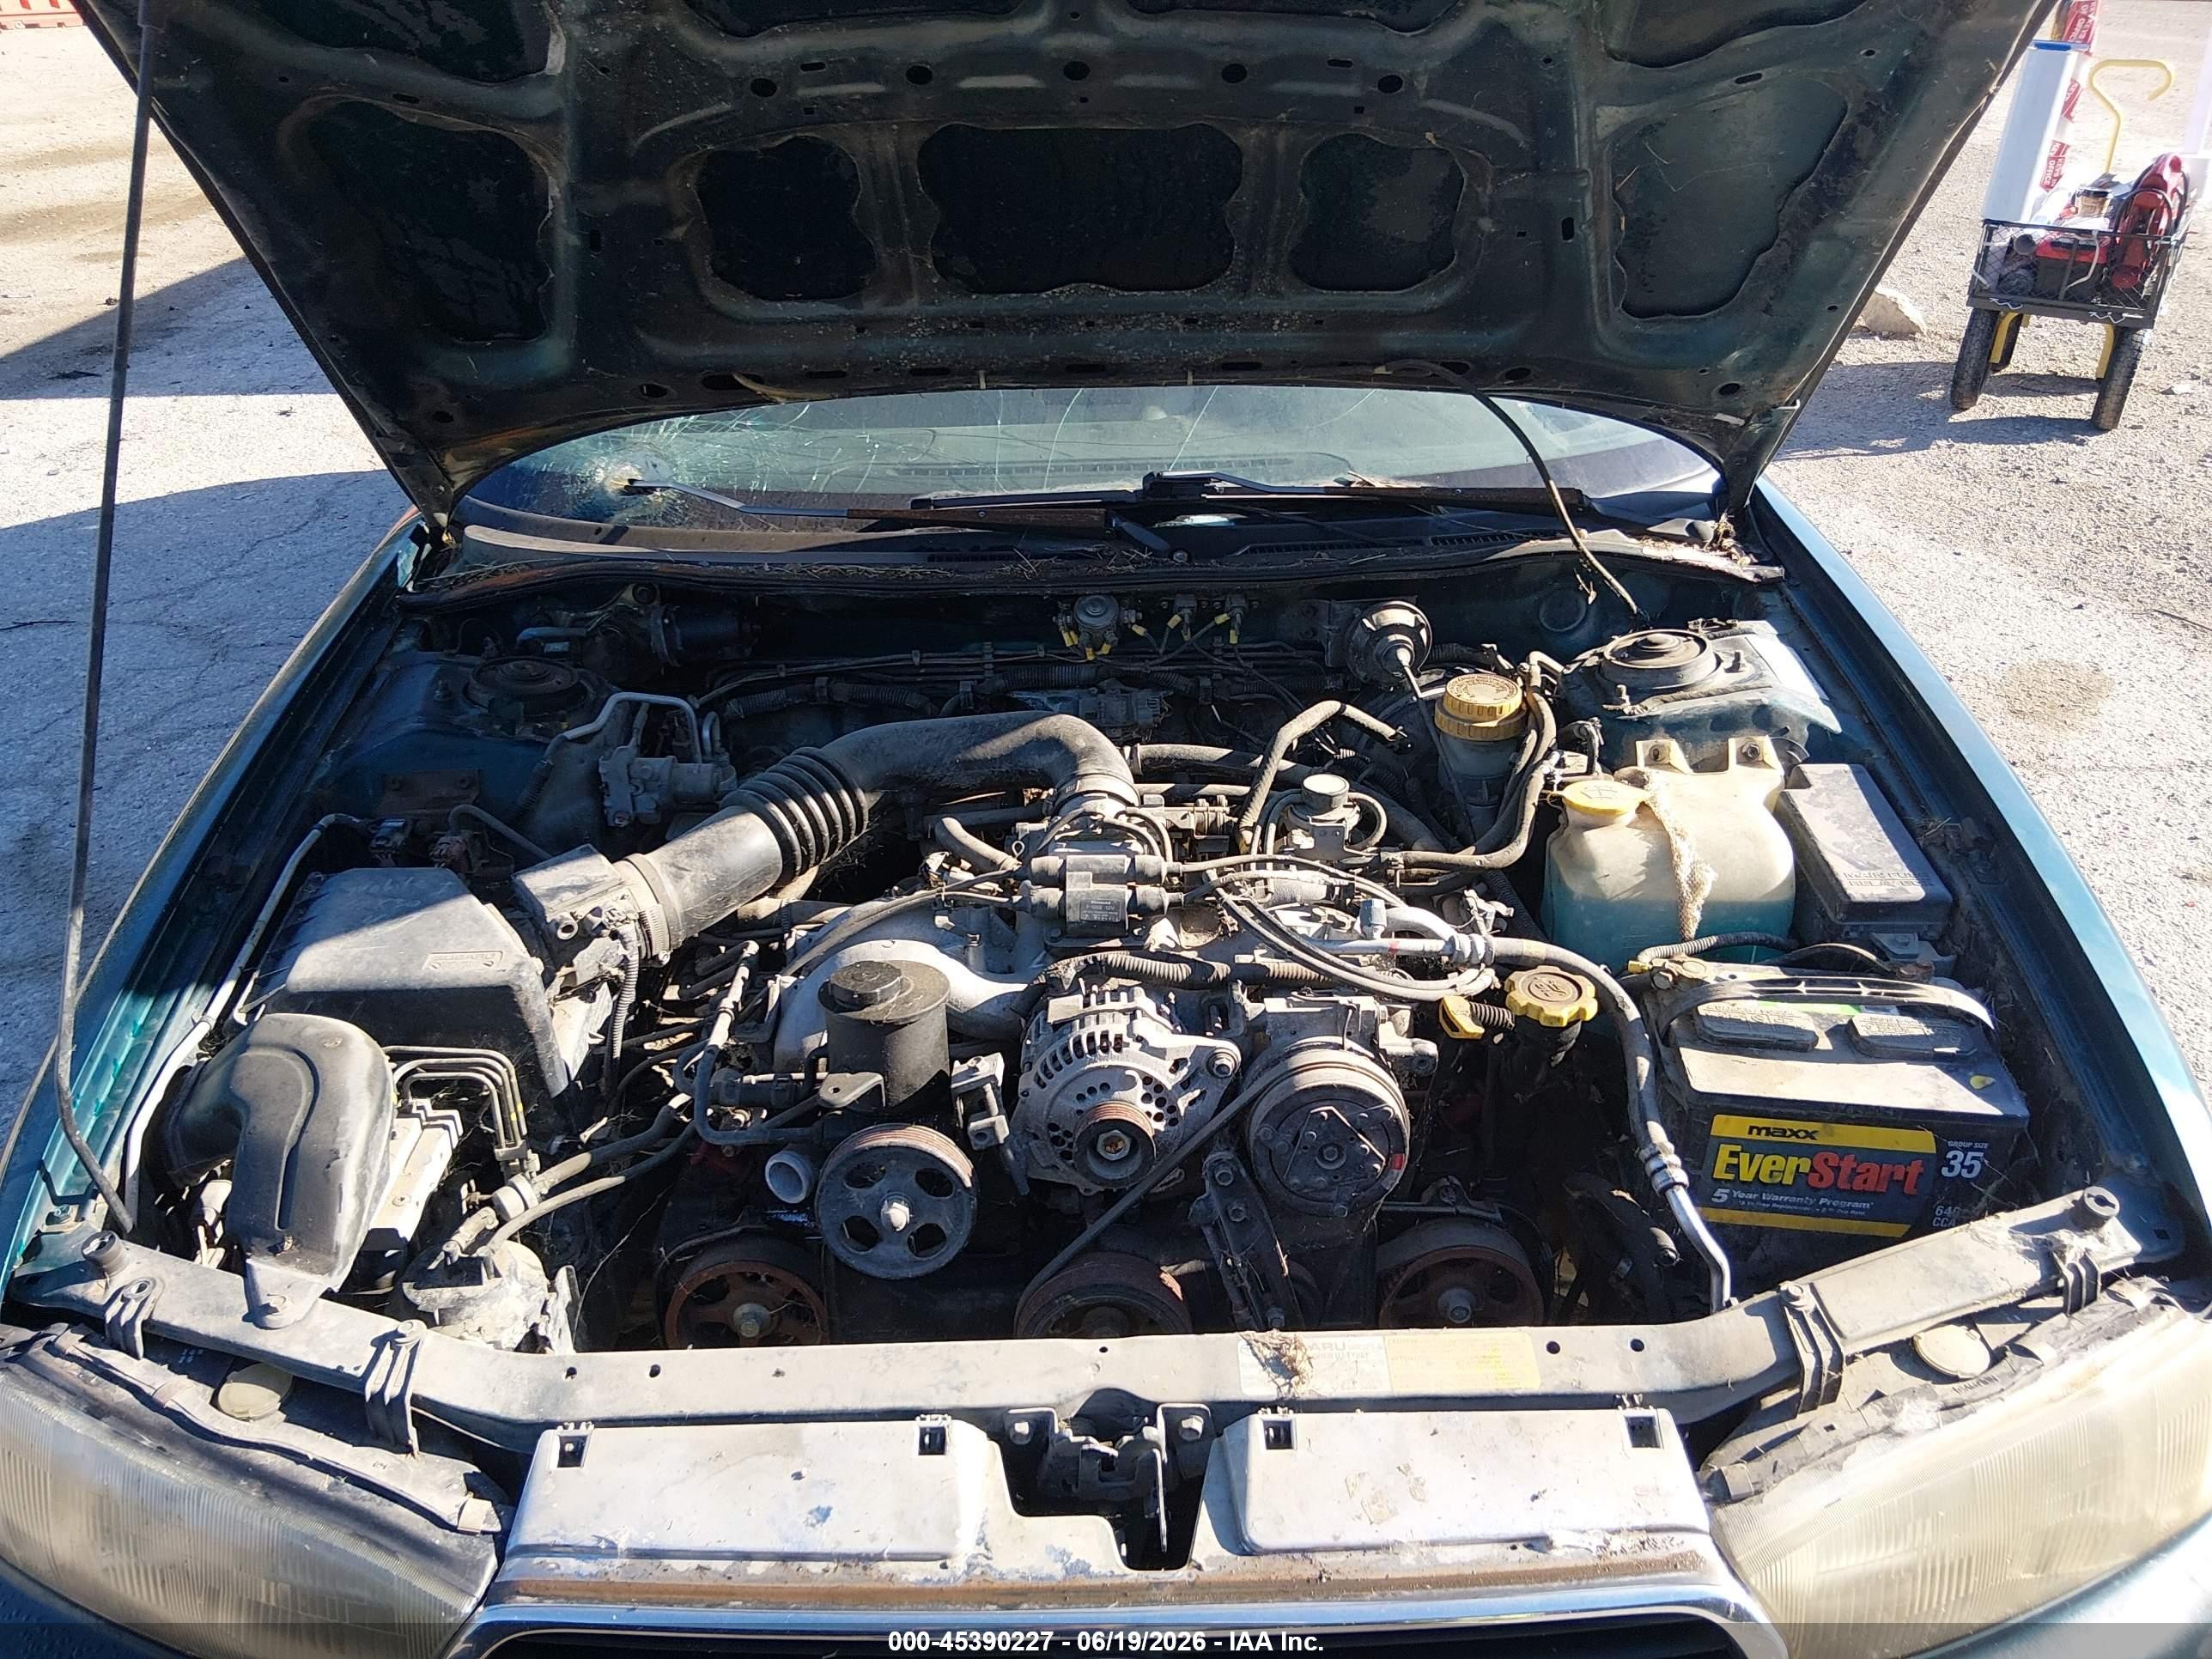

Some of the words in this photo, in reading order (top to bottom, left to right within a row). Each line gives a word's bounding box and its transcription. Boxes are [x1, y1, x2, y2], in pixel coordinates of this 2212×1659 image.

[2069, 18, 2087, 42] OFFIC
[2044, 160, 2056, 185] OFFICE
[1747, 1124, 1820, 1140] maxx
[1711, 1143, 1925, 1195] EverStart
[1941, 1149, 1985, 1179] 35
[1711, 1188, 1731, 1203] 5
[1731, 1188, 1759, 1200] Year
[1761, 1192, 1817, 1206] Warranty
[1932, 1217, 1957, 1227] CCA
